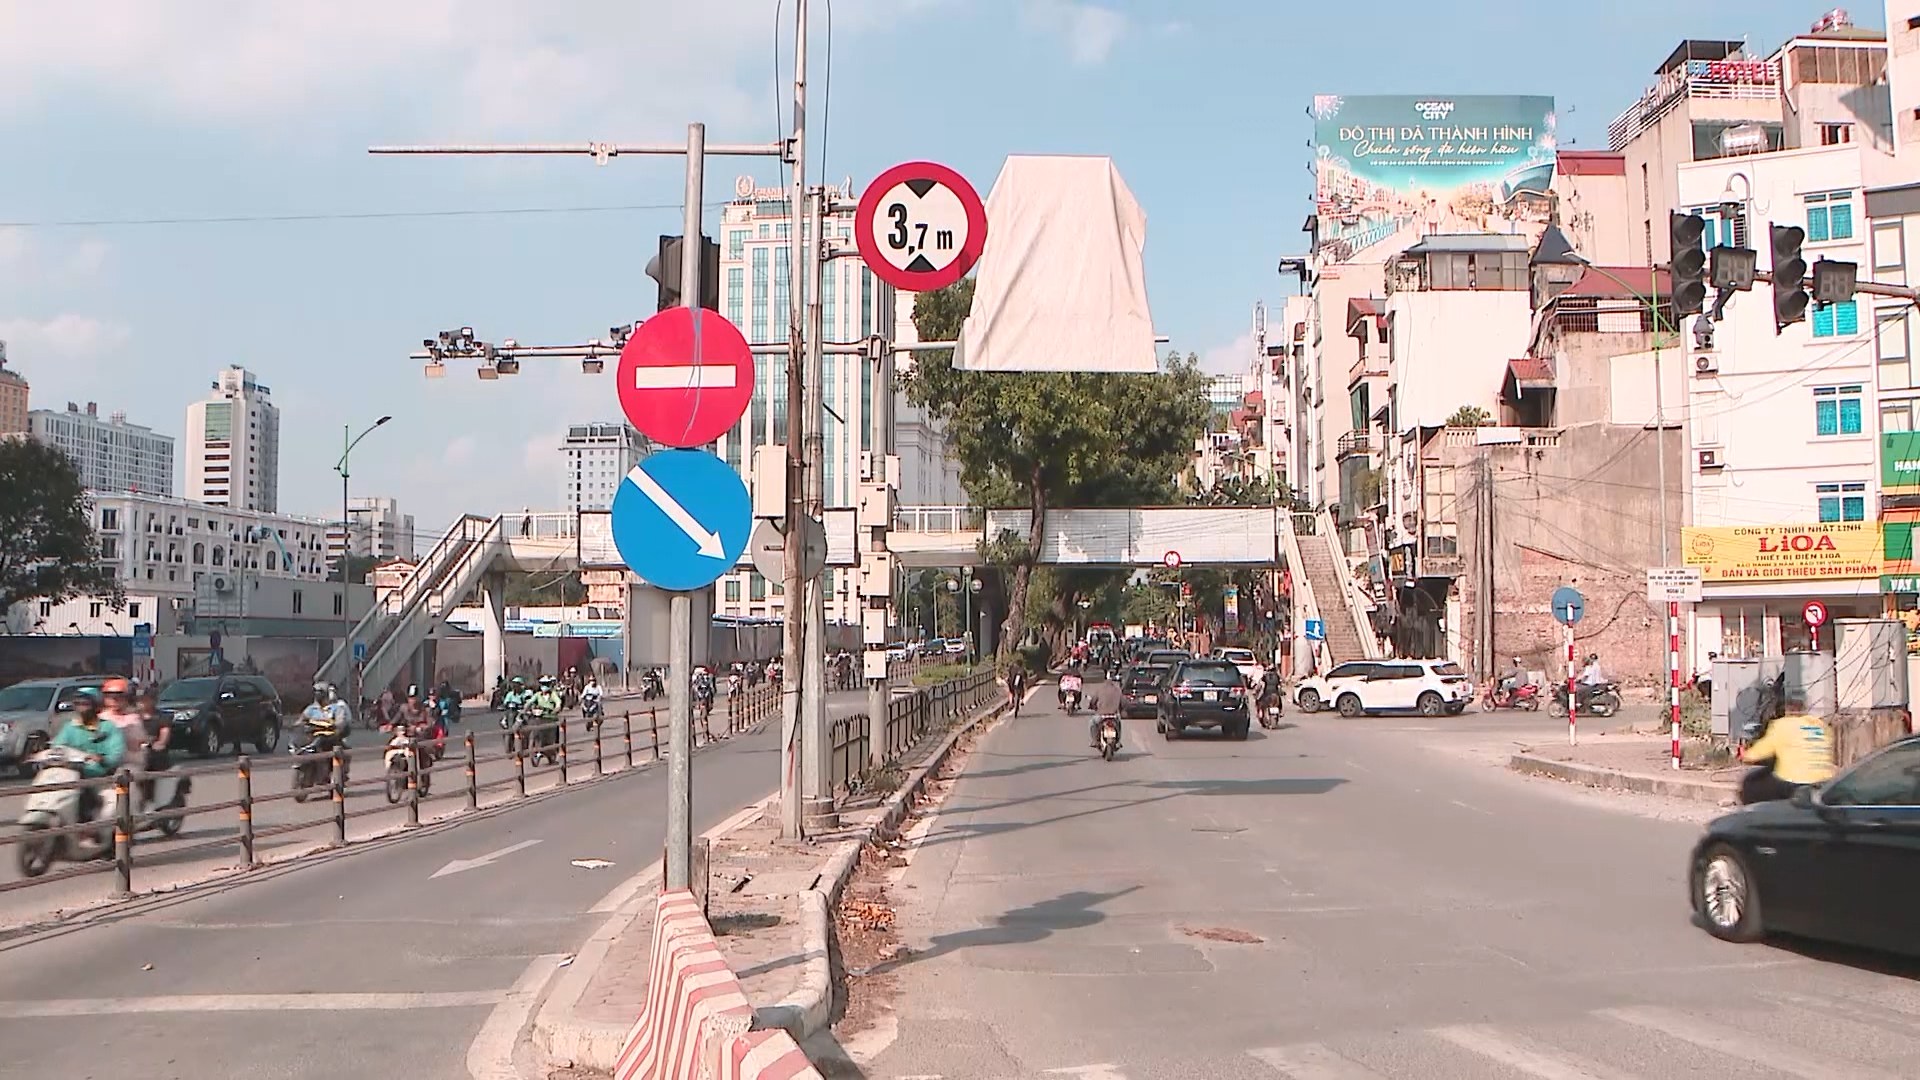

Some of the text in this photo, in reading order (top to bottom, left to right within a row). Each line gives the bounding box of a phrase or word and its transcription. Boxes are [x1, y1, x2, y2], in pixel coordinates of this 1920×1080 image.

[1415, 102, 1454, 112] OCEAN
[1422, 111, 1448, 120] CITY
[1339, 125, 1533, 142] ĐÔ THỊ ĐÃ THÀNH HÌNH
[888, 203, 953, 256] 3,7 m
[1758, 535, 1837, 552] LiOA
